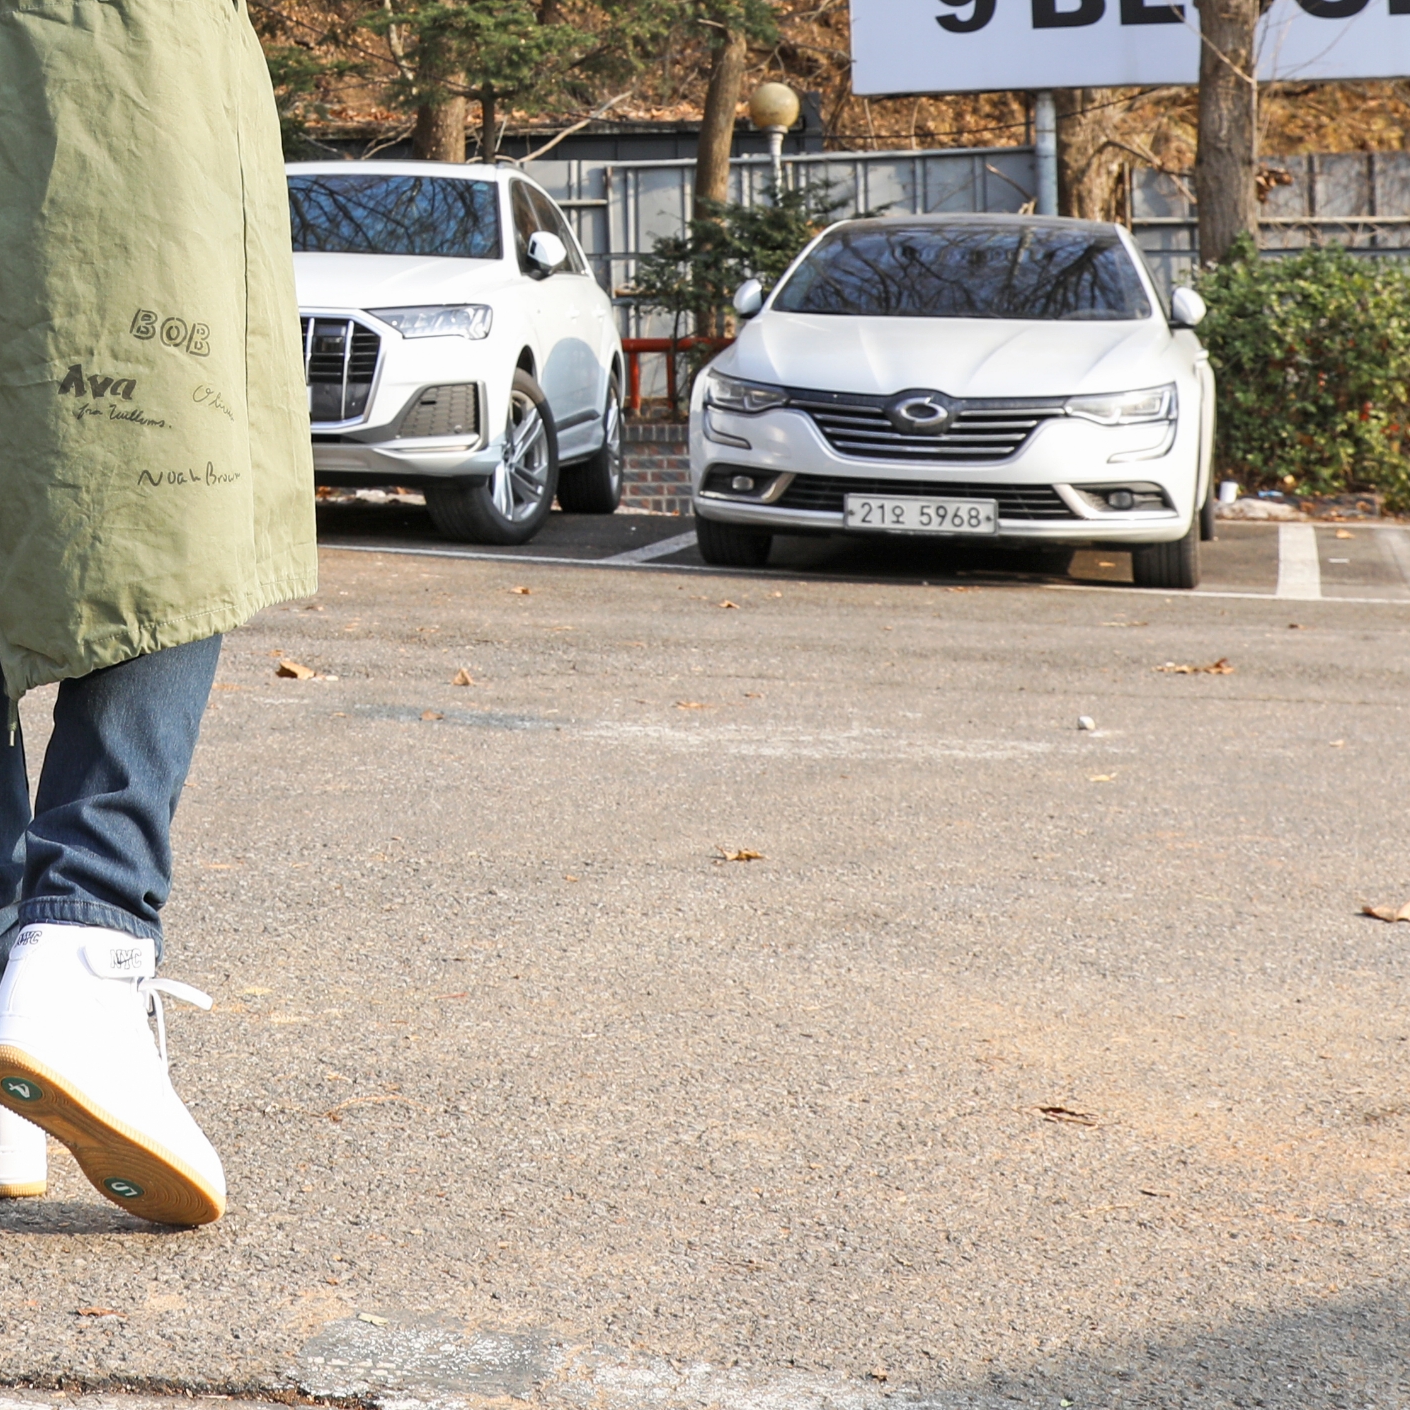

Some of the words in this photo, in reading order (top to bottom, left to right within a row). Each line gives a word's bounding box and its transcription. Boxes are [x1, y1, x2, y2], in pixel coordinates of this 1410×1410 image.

[129, 308, 211, 358] BOB
[58, 363, 137, 400] Ava
[137, 469, 201, 487] Noah
[204, 460, 241, 487] Brown
[860, 501, 906, 525] 21오
[918, 504, 982, 528] 5968
[110, 948, 142, 970] NYC
